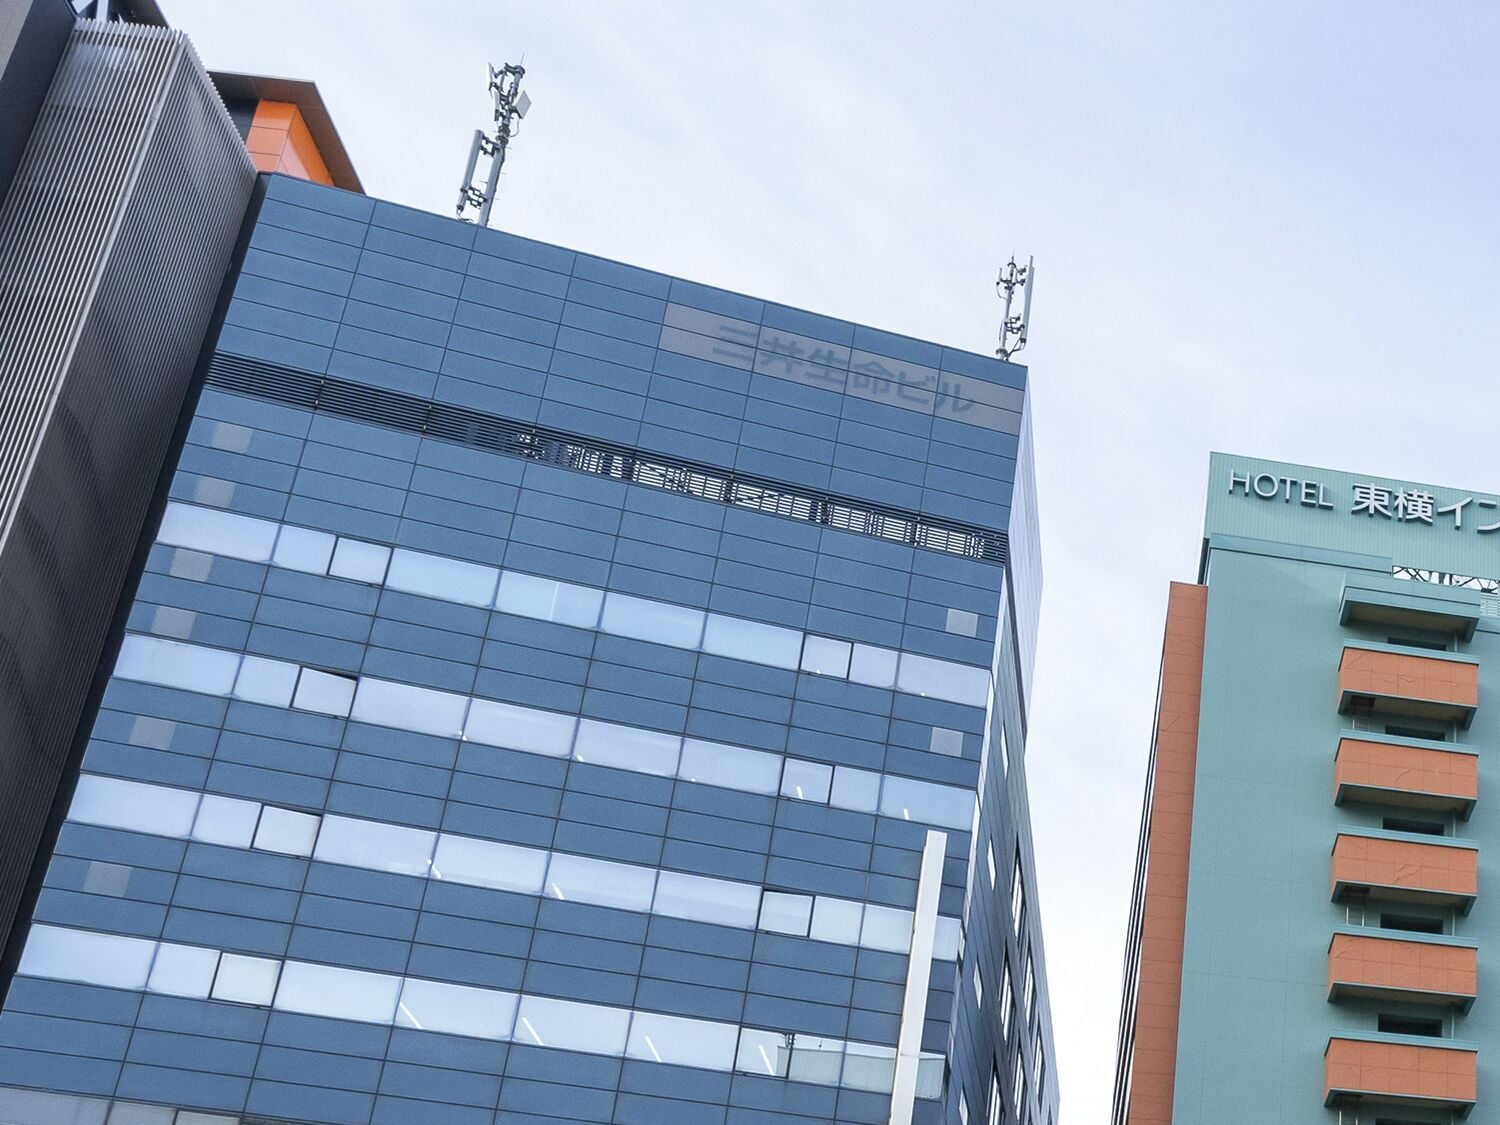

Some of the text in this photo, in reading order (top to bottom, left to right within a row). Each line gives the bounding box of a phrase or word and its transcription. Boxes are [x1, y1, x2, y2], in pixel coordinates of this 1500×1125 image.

[712, 323, 978, 415] 三井生命ビル
[1228, 467, 1334, 511] HOTEL
